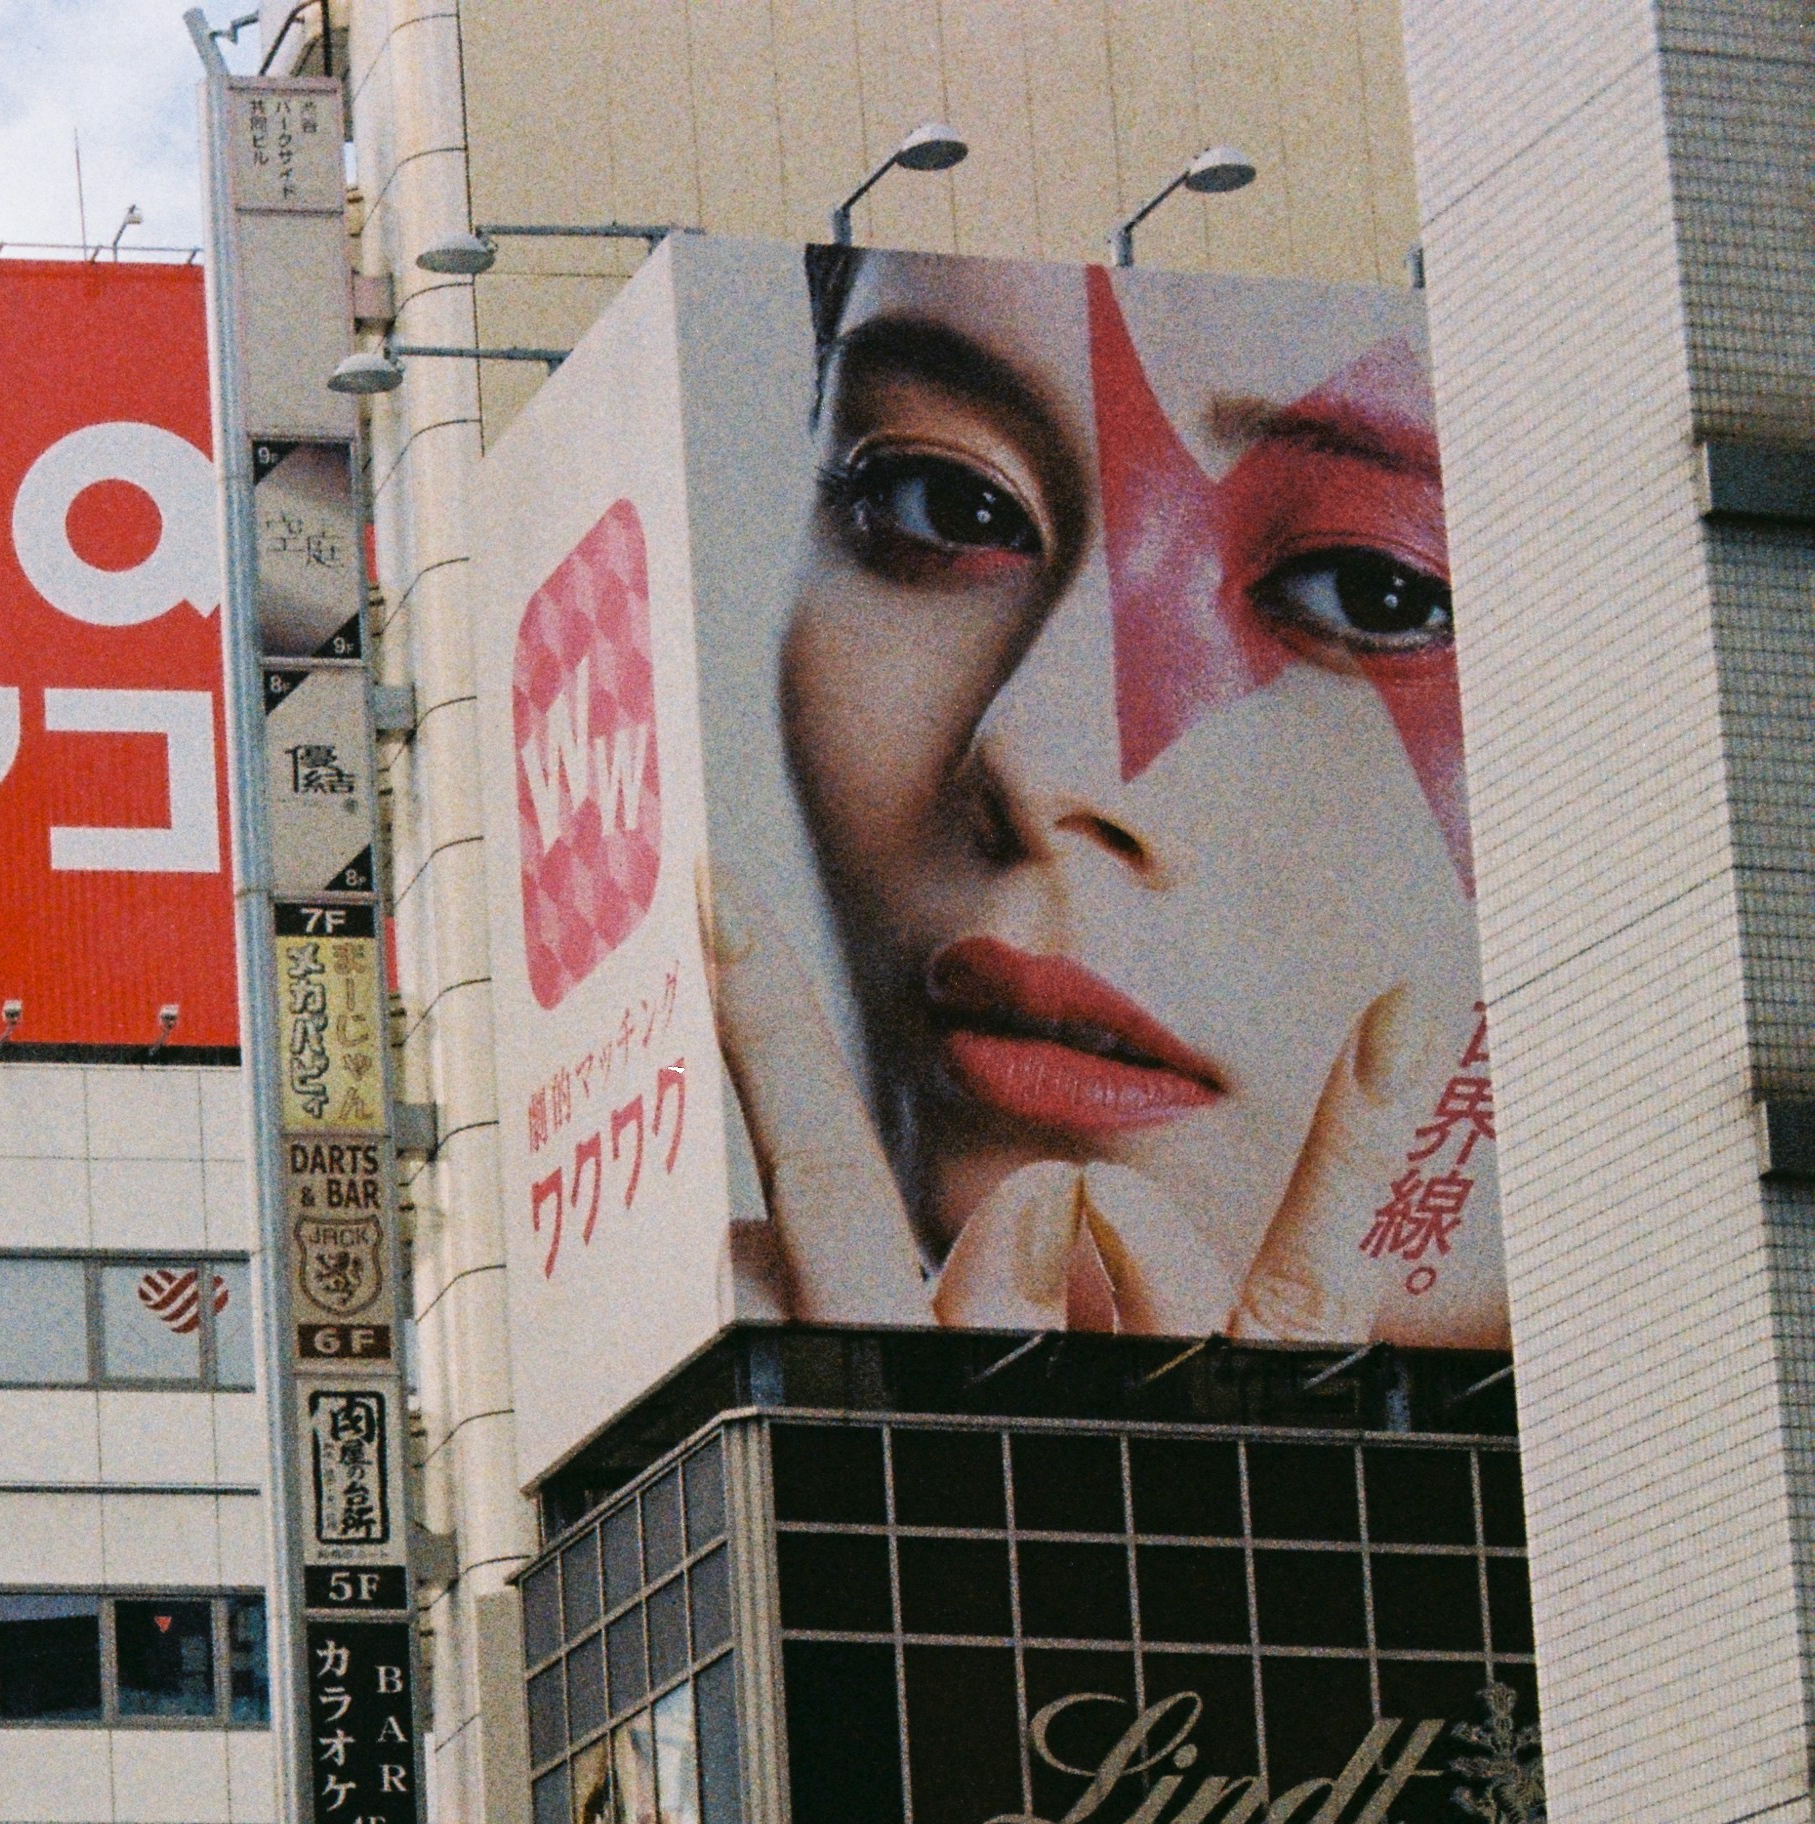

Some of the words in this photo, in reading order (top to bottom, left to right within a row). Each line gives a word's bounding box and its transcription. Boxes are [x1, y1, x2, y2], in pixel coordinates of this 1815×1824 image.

[301, 908, 347, 934] 7F
[290, 1144, 381, 1177] DARTS
[1359, 1000, 1497, 1296] 界線。
[301, 1187, 314, 1208] &
[326, 1180, 381, 1210] BAR
[307, 1225, 371, 1247] JACK
[328, 1571, 380, 1602] 5F
[316, 1640, 357, 1812] カラオケ
